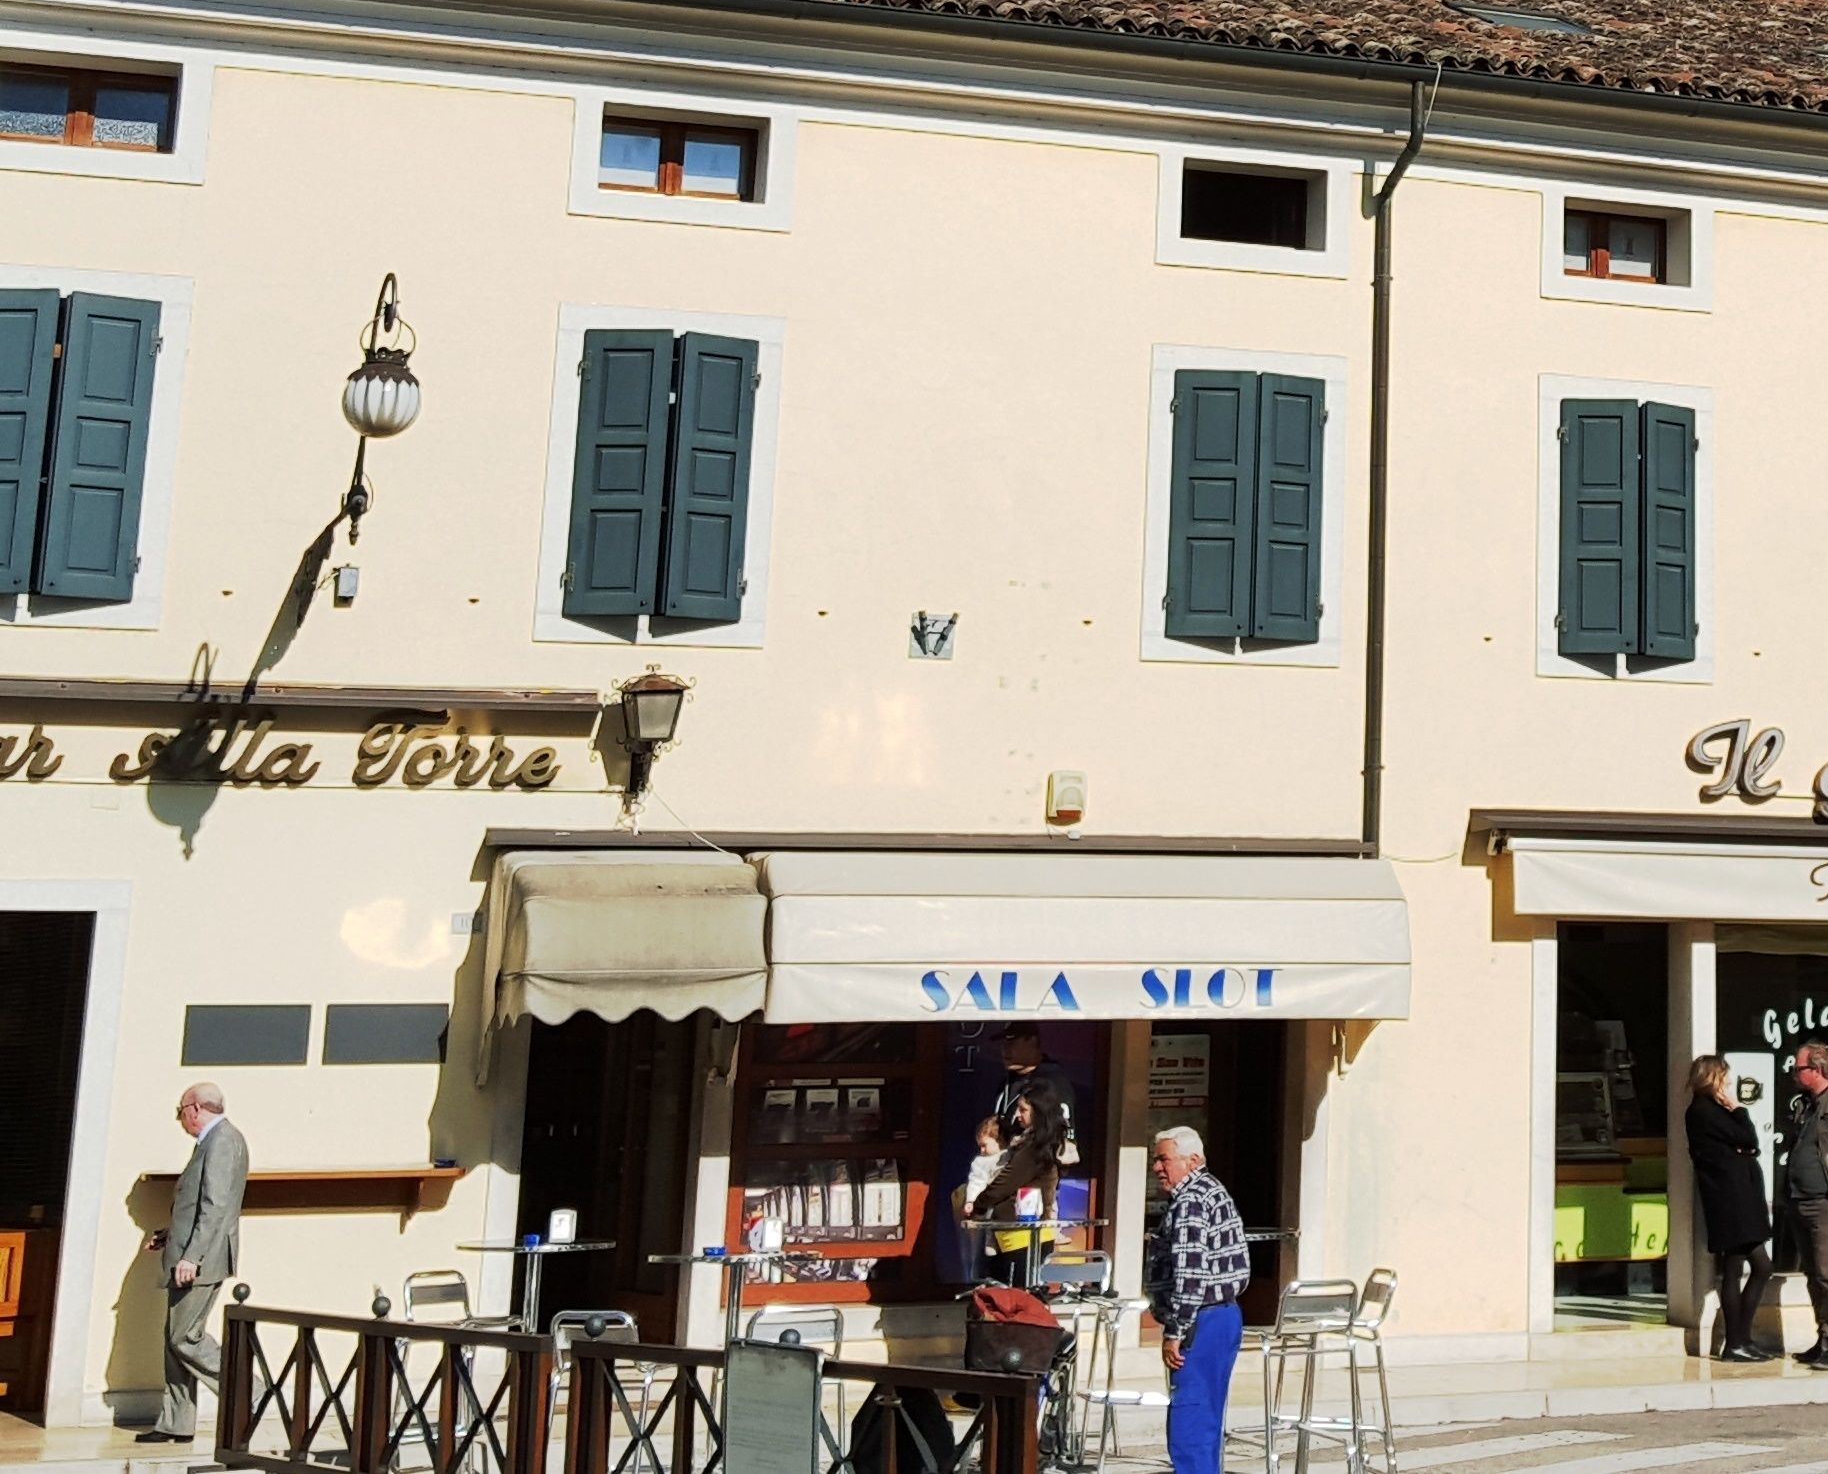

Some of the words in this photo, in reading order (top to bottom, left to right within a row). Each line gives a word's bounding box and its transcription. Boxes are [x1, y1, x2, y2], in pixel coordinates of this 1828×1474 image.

[352, 708, 562, 788] Torre
[1686, 719, 1785, 804] Il
[919, 970, 1082, 1013] SALA
[1139, 967, 1285, 1009] SLOT
